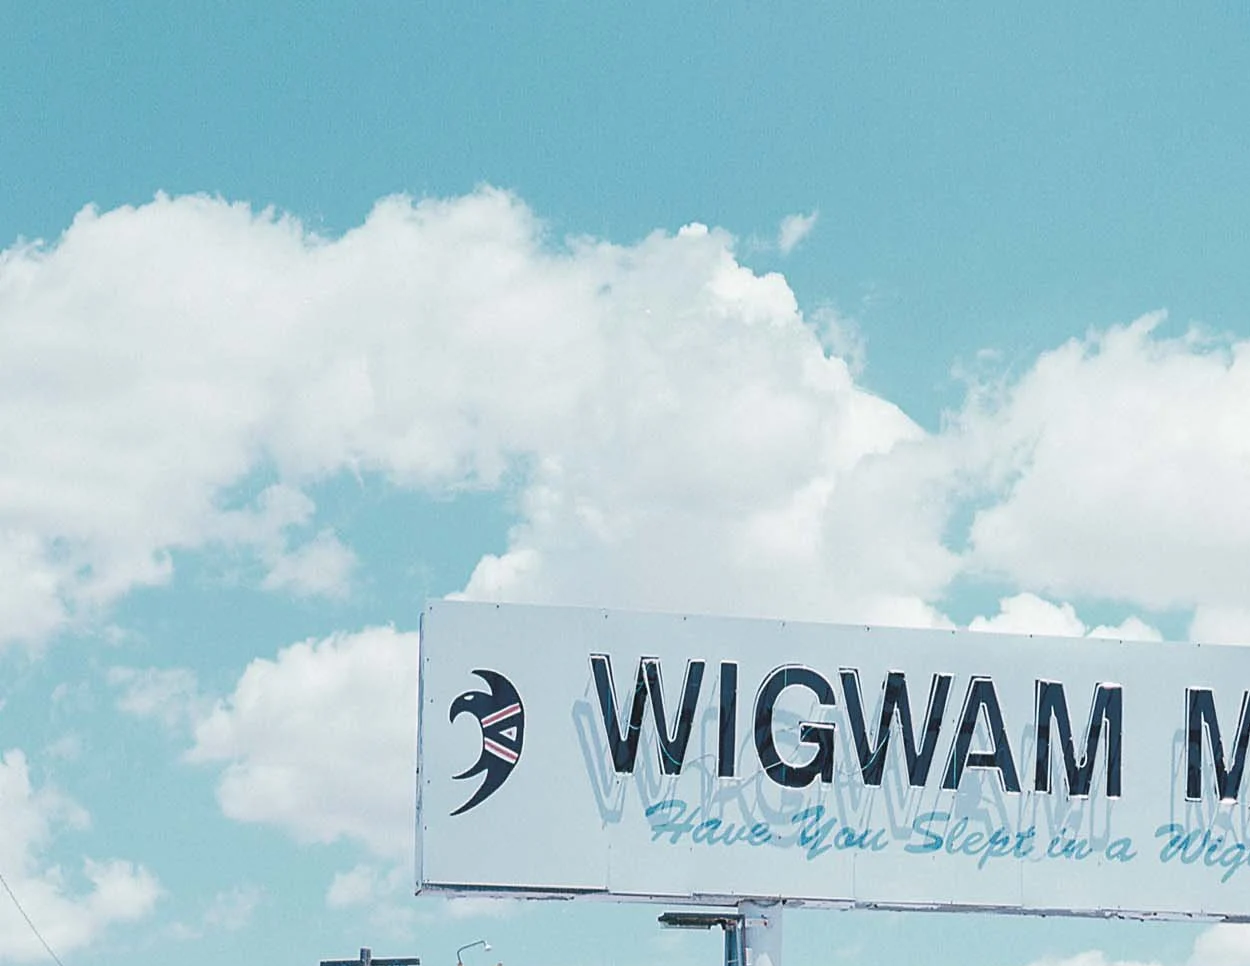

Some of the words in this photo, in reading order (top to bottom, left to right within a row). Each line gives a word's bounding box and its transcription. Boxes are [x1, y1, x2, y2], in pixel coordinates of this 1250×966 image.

[588, 653, 1124, 799] WIGWAM
[645, 800, 773, 846] Have
[792, 805, 889, 861] You
[903, 811, 1039, 870] Slept
[1046, 824, 1093, 860] in
[1106, 838, 1136, 864] a
